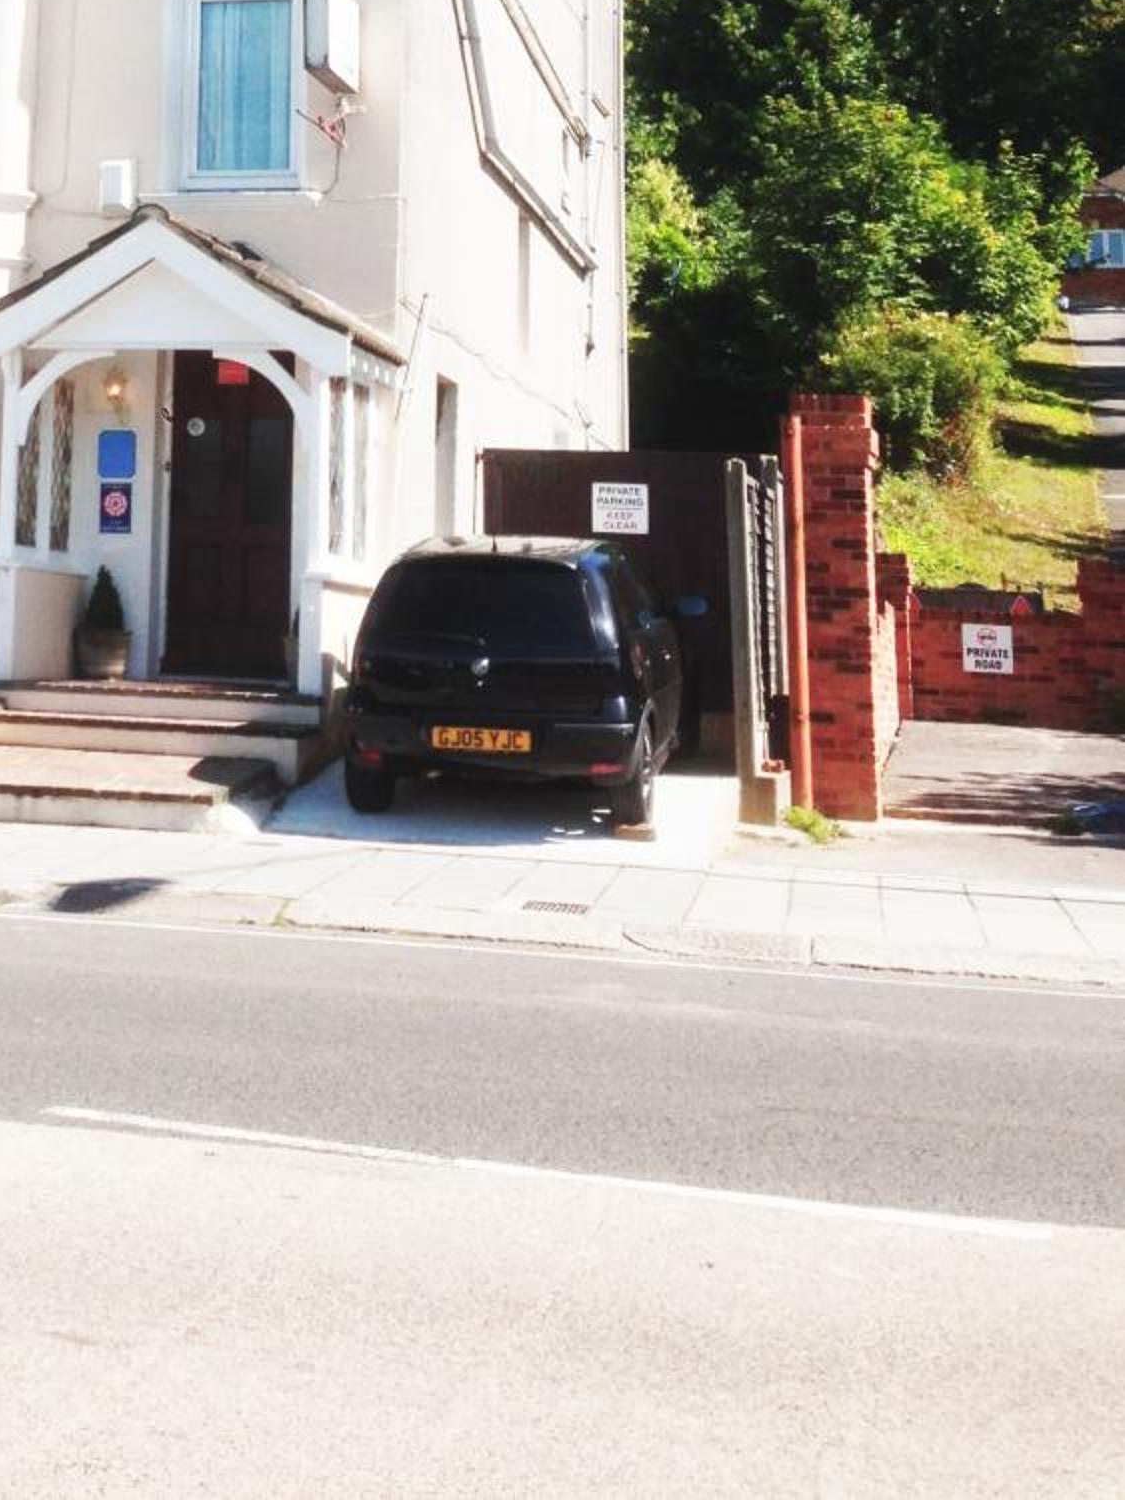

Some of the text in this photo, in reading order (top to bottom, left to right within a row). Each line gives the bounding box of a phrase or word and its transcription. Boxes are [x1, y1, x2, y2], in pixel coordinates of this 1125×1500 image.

[598, 486, 642, 496] PRIVATE
[597, 497, 644, 507] PARKING
[966, 647, 1009, 659] PRIVATE
[974, 659, 1002, 669] ROAD
[489, 731, 525, 750] YJC
